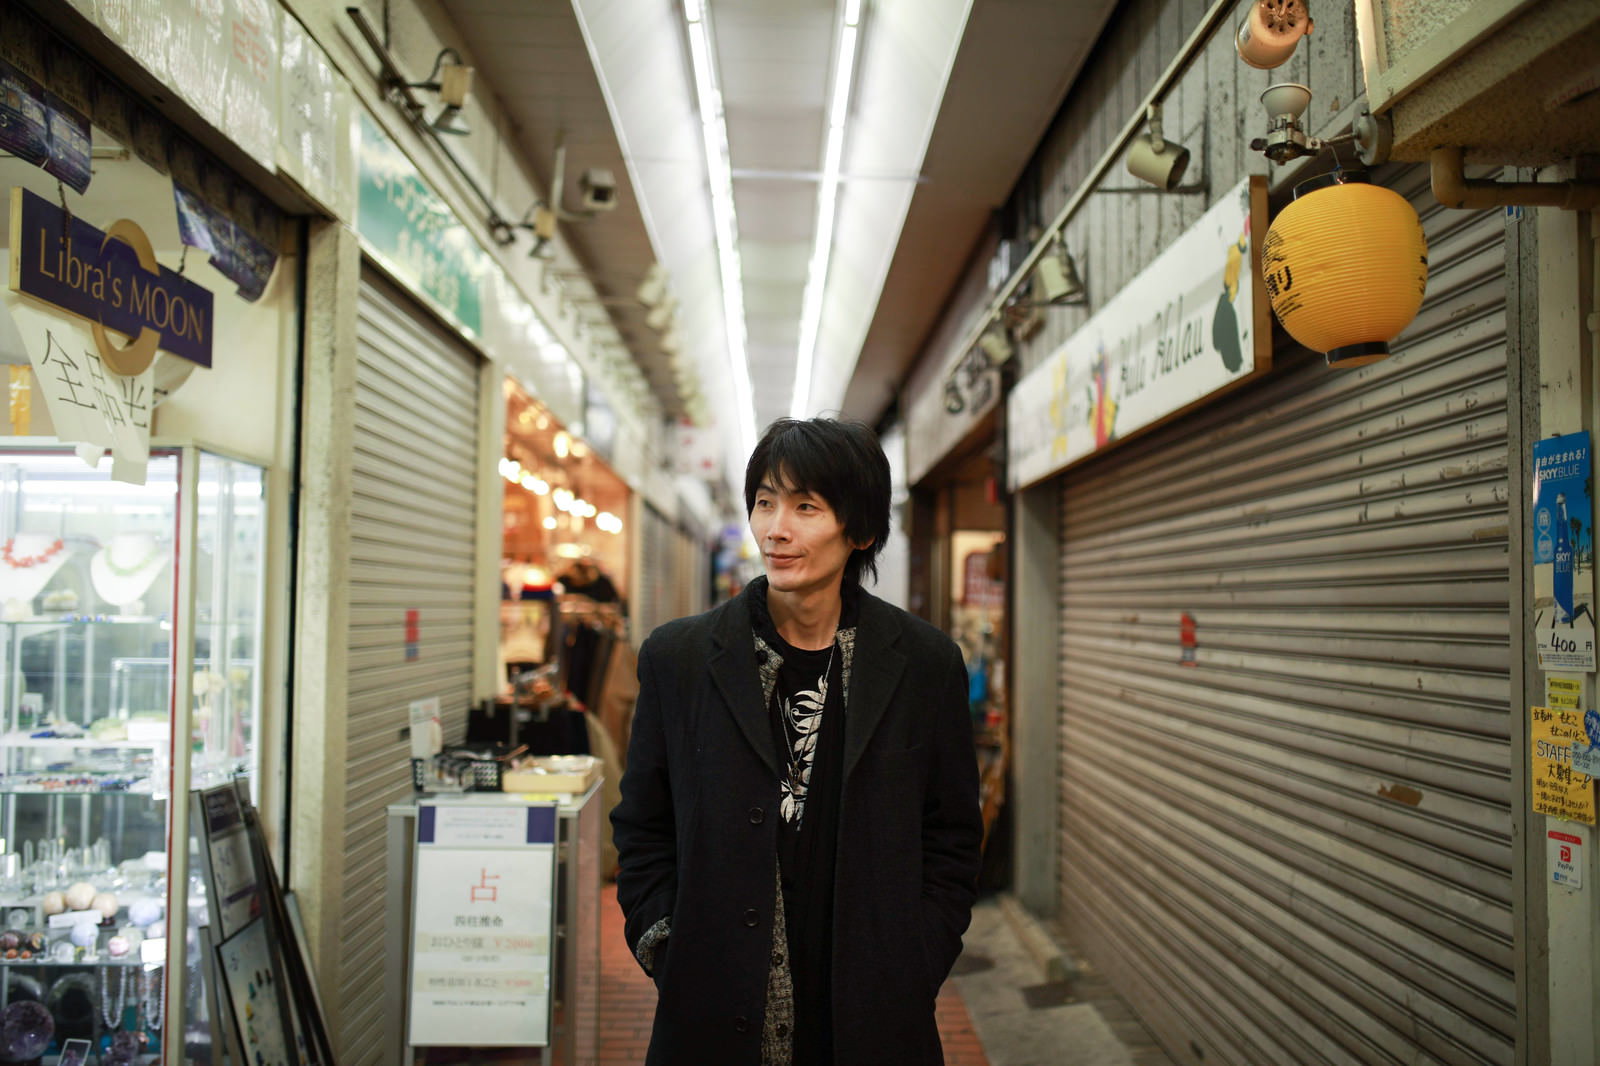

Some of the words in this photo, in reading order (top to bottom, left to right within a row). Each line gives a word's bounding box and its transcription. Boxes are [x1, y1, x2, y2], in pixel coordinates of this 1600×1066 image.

[40, 228, 122, 308] Libra's
[129, 275, 206, 345] MOON
[1551, 632, 1576, 653] 400
[1537, 740, 1571, 763] STAFF
[1557, 861, 1574, 872] PayPay
[470, 868, 500, 903] 占
